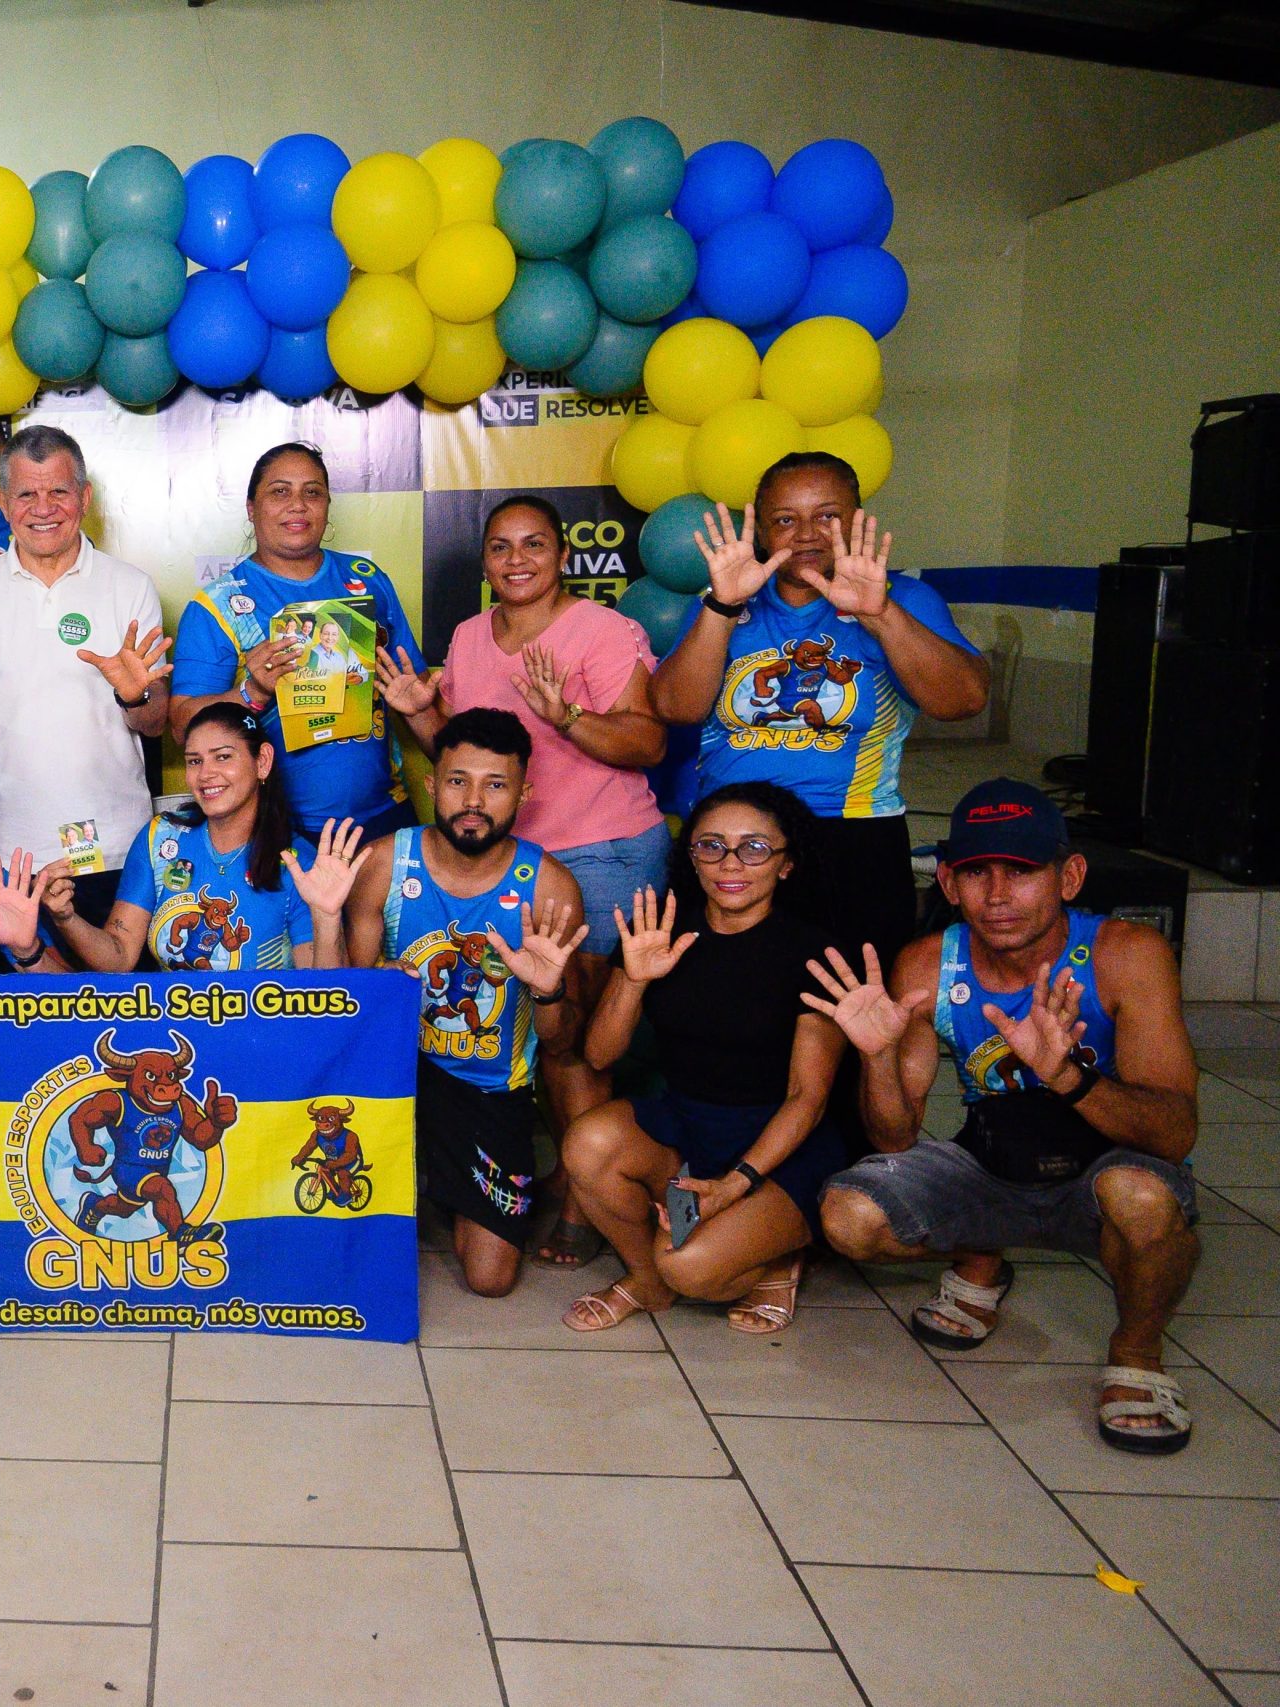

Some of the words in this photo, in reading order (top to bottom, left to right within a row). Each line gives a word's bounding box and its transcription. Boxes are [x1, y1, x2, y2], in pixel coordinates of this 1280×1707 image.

[482, 401, 534, 421] QUE
[546, 397, 649, 418] RESOLVE
[293, 684, 327, 692] BOSCO
[308, 714, 336, 728] 55555
[729, 730, 845, 751] GNUS
[68, 843, 95, 854] BOSCO
[169, 986, 245, 1024] Seja
[253, 984, 357, 1016] Gnus.
[422, 1025, 501, 1060] NUS
[7, 1057, 93, 1149] ESPORTES
[138, 1148, 170, 1160] GNUS
[5, 1153, 49, 1236] EQUIPE
[27, 1238, 227, 1289] GNUS
[104, 1302, 203, 1327] chama,
[209, 1298, 258, 1324] nós
[263, 1307, 363, 1328] vamos.
